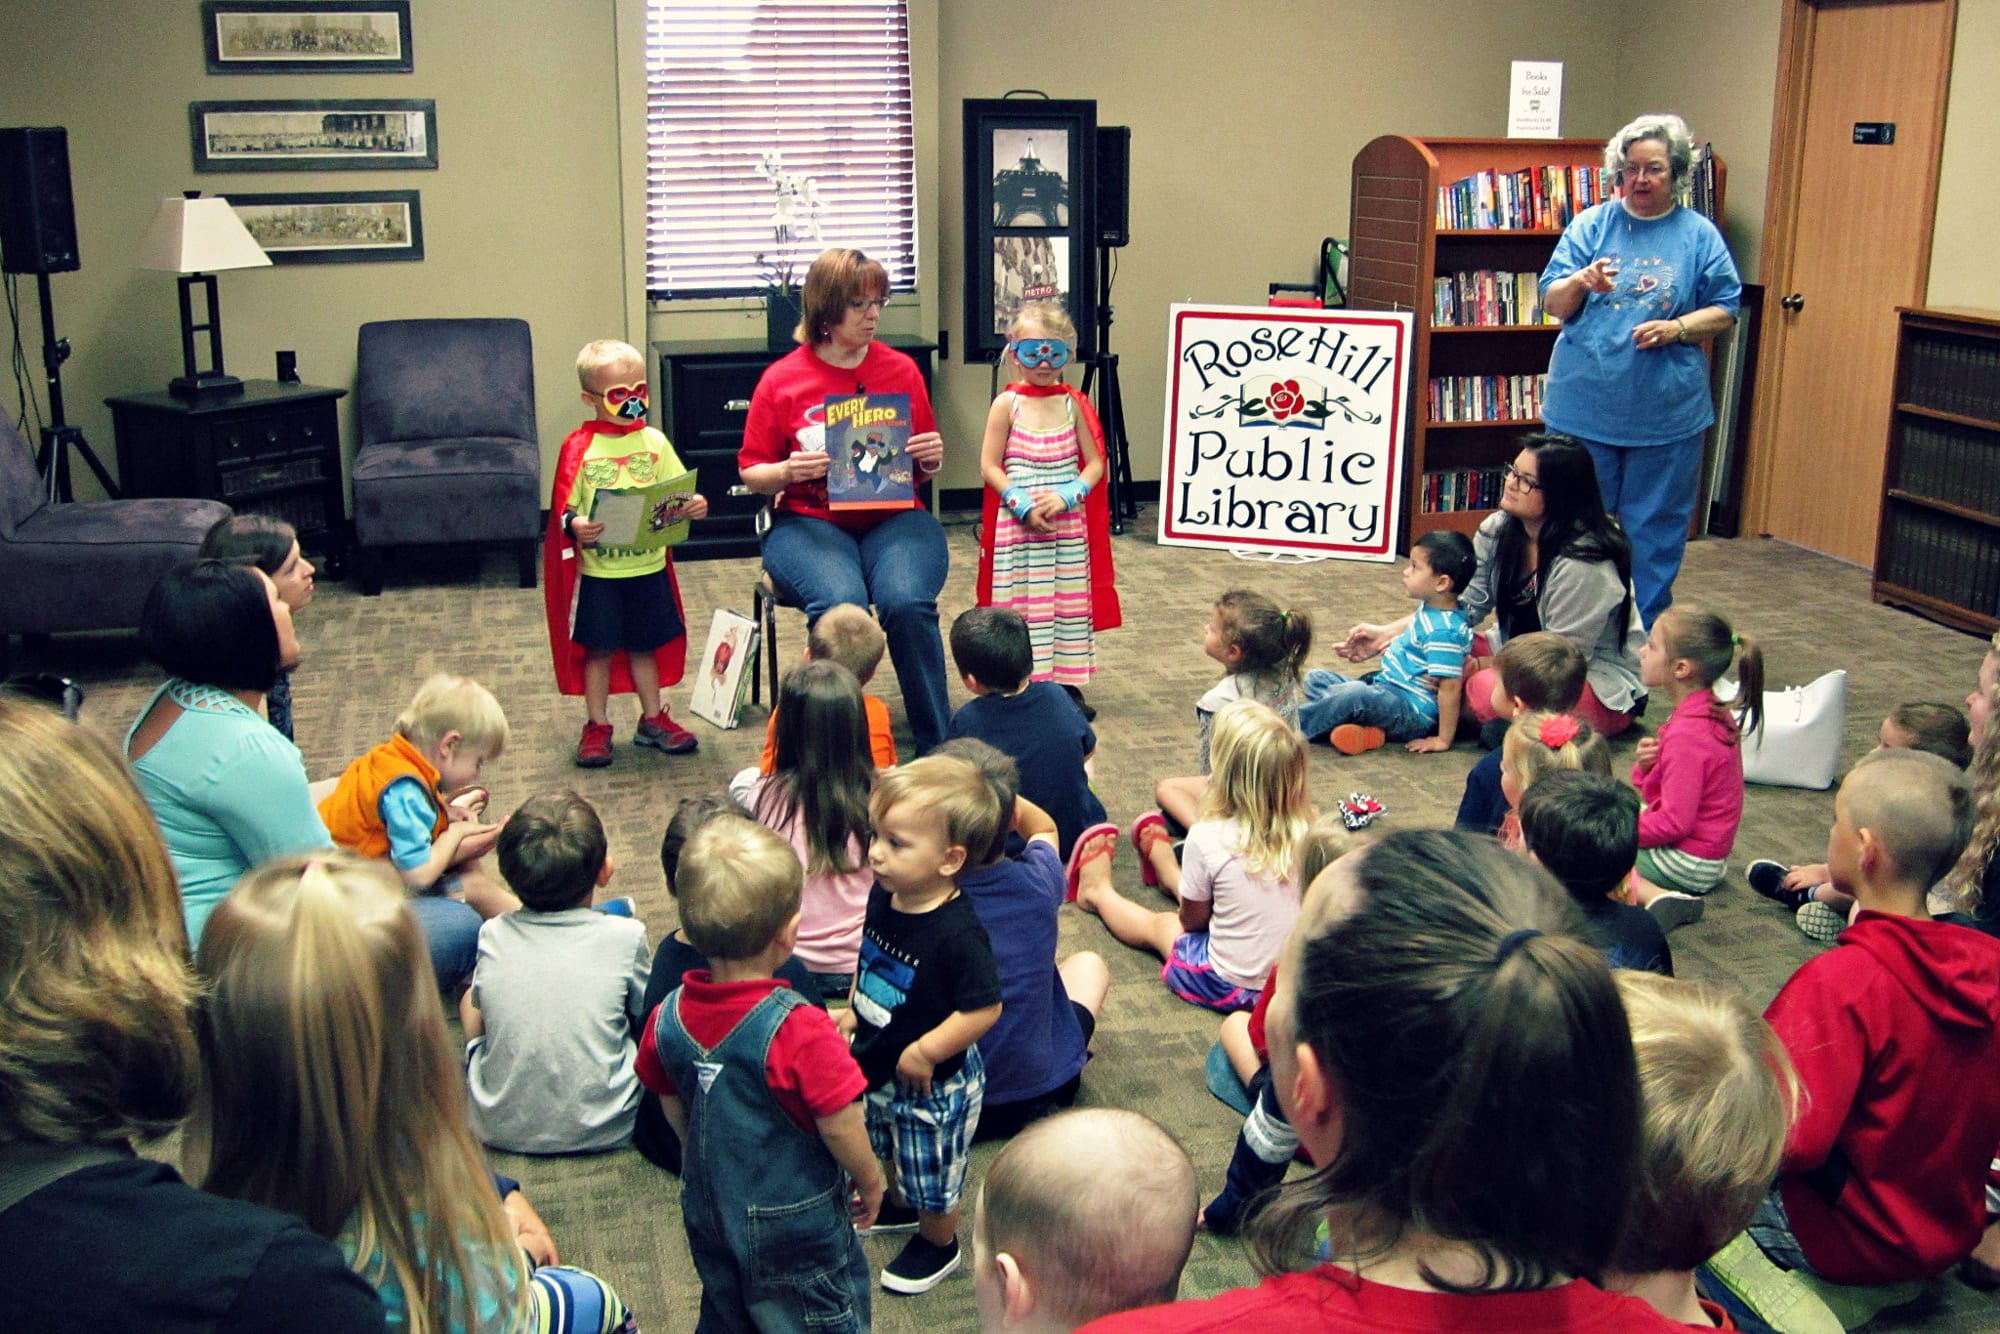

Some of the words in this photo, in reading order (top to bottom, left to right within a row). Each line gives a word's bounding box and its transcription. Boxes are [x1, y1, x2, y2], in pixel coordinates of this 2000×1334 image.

[1183, 327, 1304, 392] Rose
[1306, 326, 1393, 395] Hill
[826, 396, 869, 428] EVERY
[852, 407, 898, 428] HERO
[1185, 430, 1375, 485] Public
[1178, 481, 1380, 543] Library
